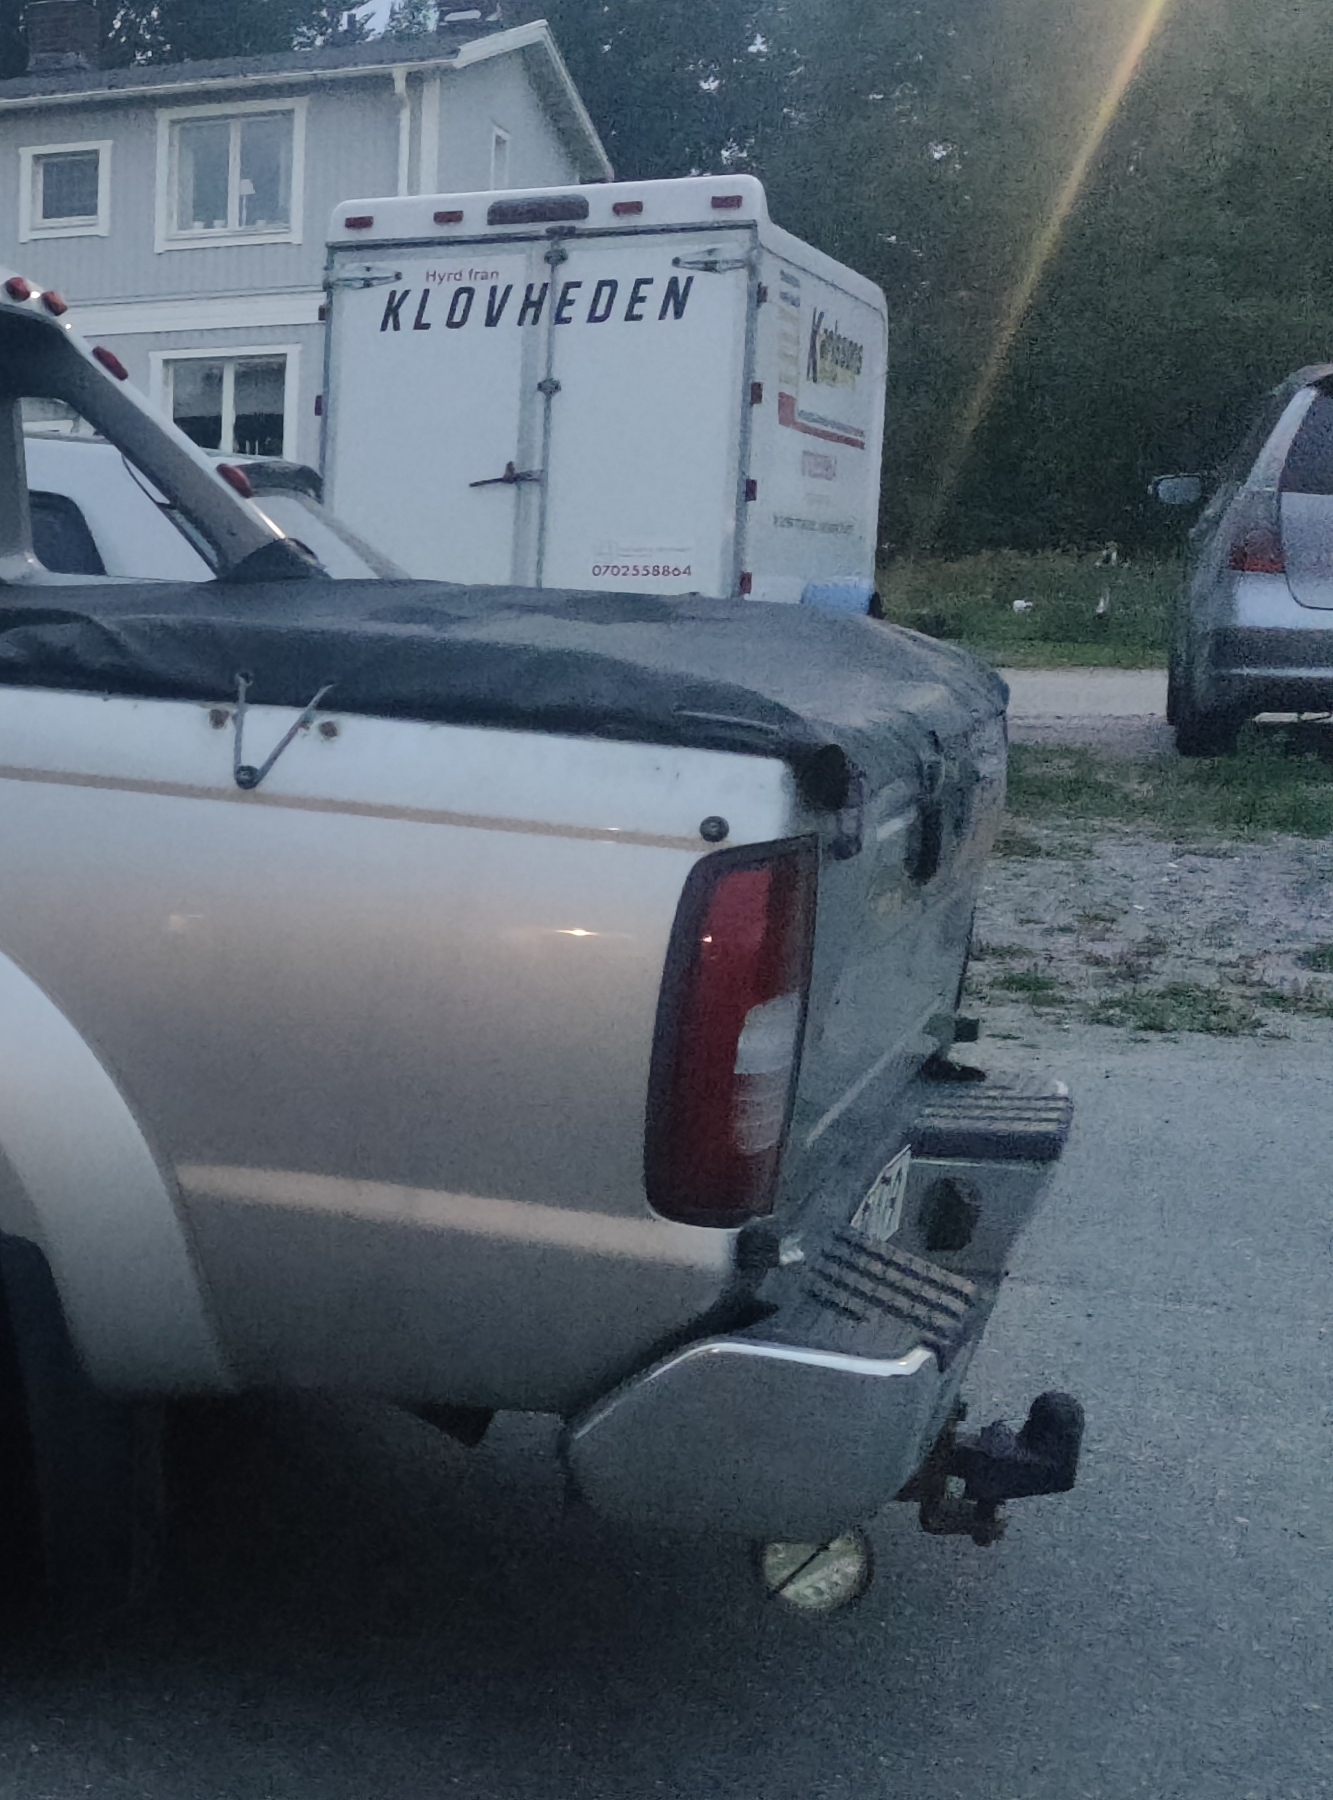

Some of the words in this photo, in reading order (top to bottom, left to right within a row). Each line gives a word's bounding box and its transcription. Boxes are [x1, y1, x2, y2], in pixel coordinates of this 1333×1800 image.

[425, 269, 463, 286] Hyrd
[379, 275, 695, 332] KLOVHEDEN
[591, 564, 692, 577] 0702558864
